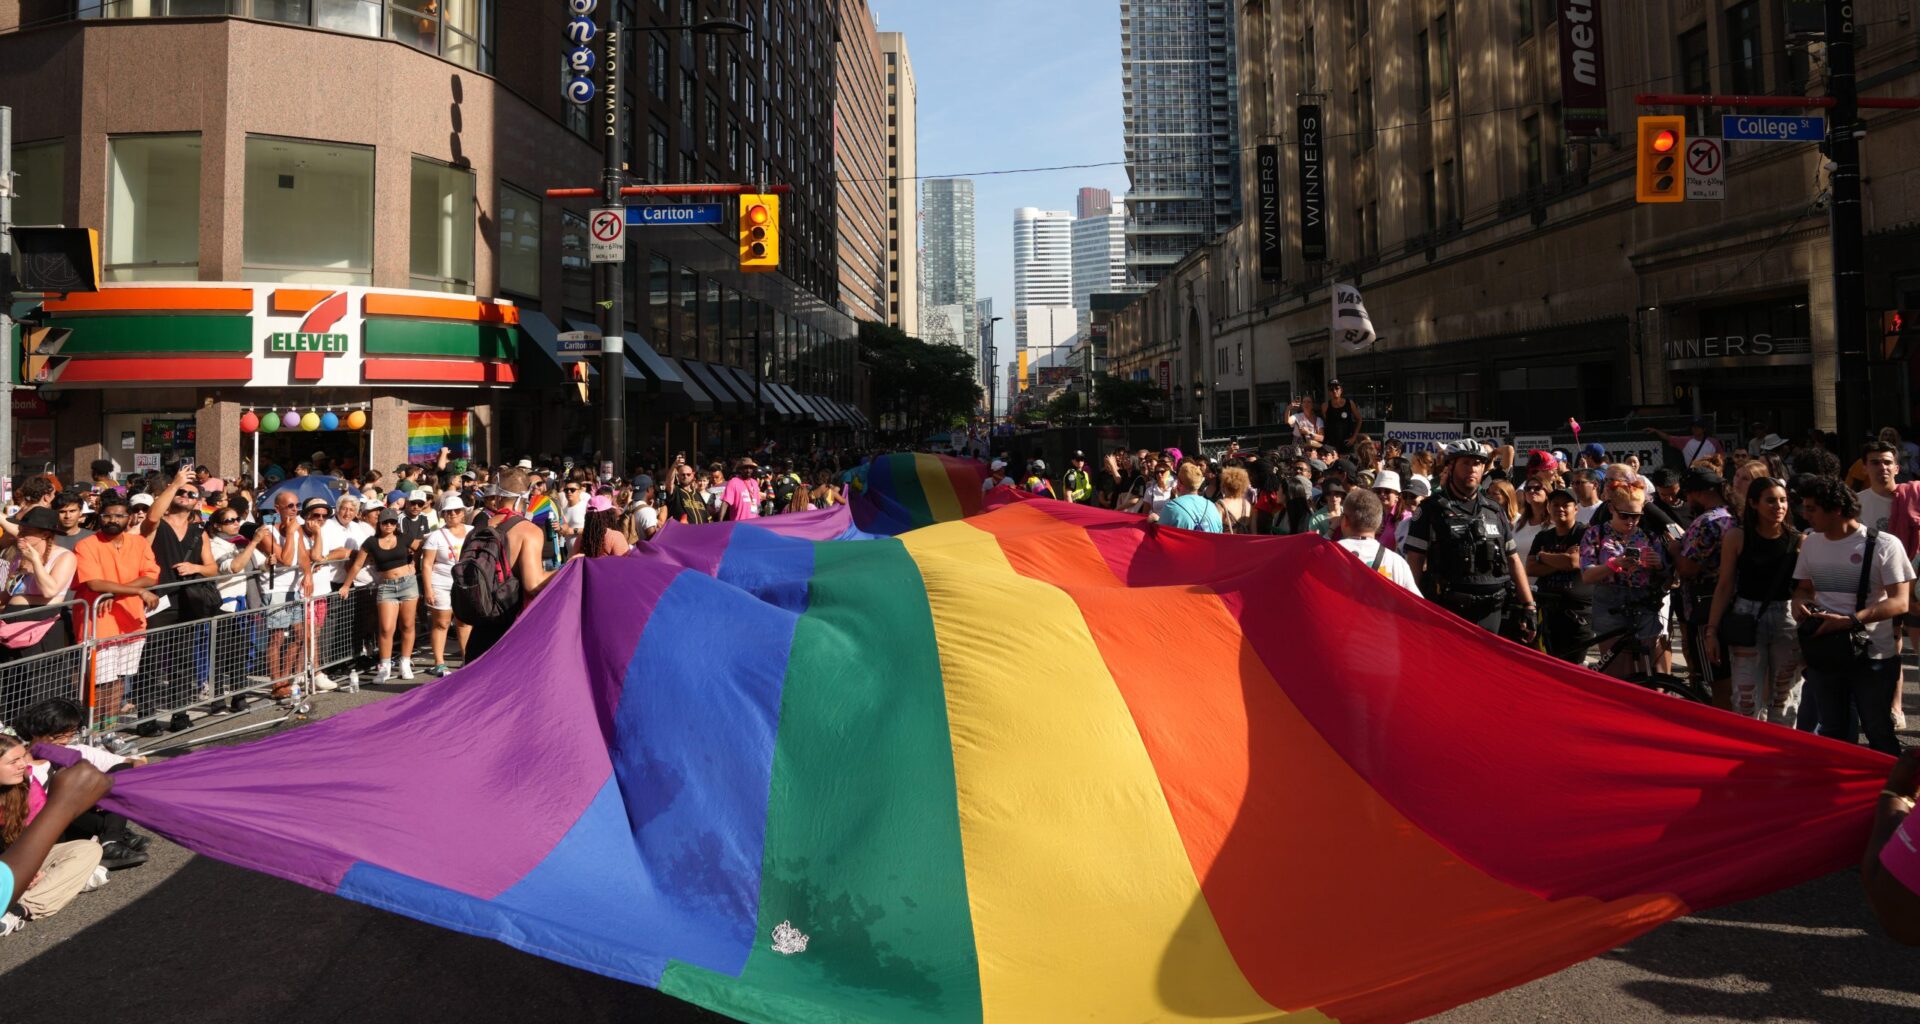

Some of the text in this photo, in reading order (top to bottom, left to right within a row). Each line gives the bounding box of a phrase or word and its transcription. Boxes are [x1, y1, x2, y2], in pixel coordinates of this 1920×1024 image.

[1841, 0, 1853, 32] DO
[605, 32, 617, 136] DOWNTOWN
[1737, 118, 1810, 138] College St
[1303, 117, 1321, 227] WINNERS
[643, 207, 694, 220] Carlton
[1262, 154, 1276, 251] WINNERS
[1664, 333, 1774, 358] INNERS
[1387, 431, 1461, 440] CONSTRUCTION
[1474, 426, 1507, 438] GATE
